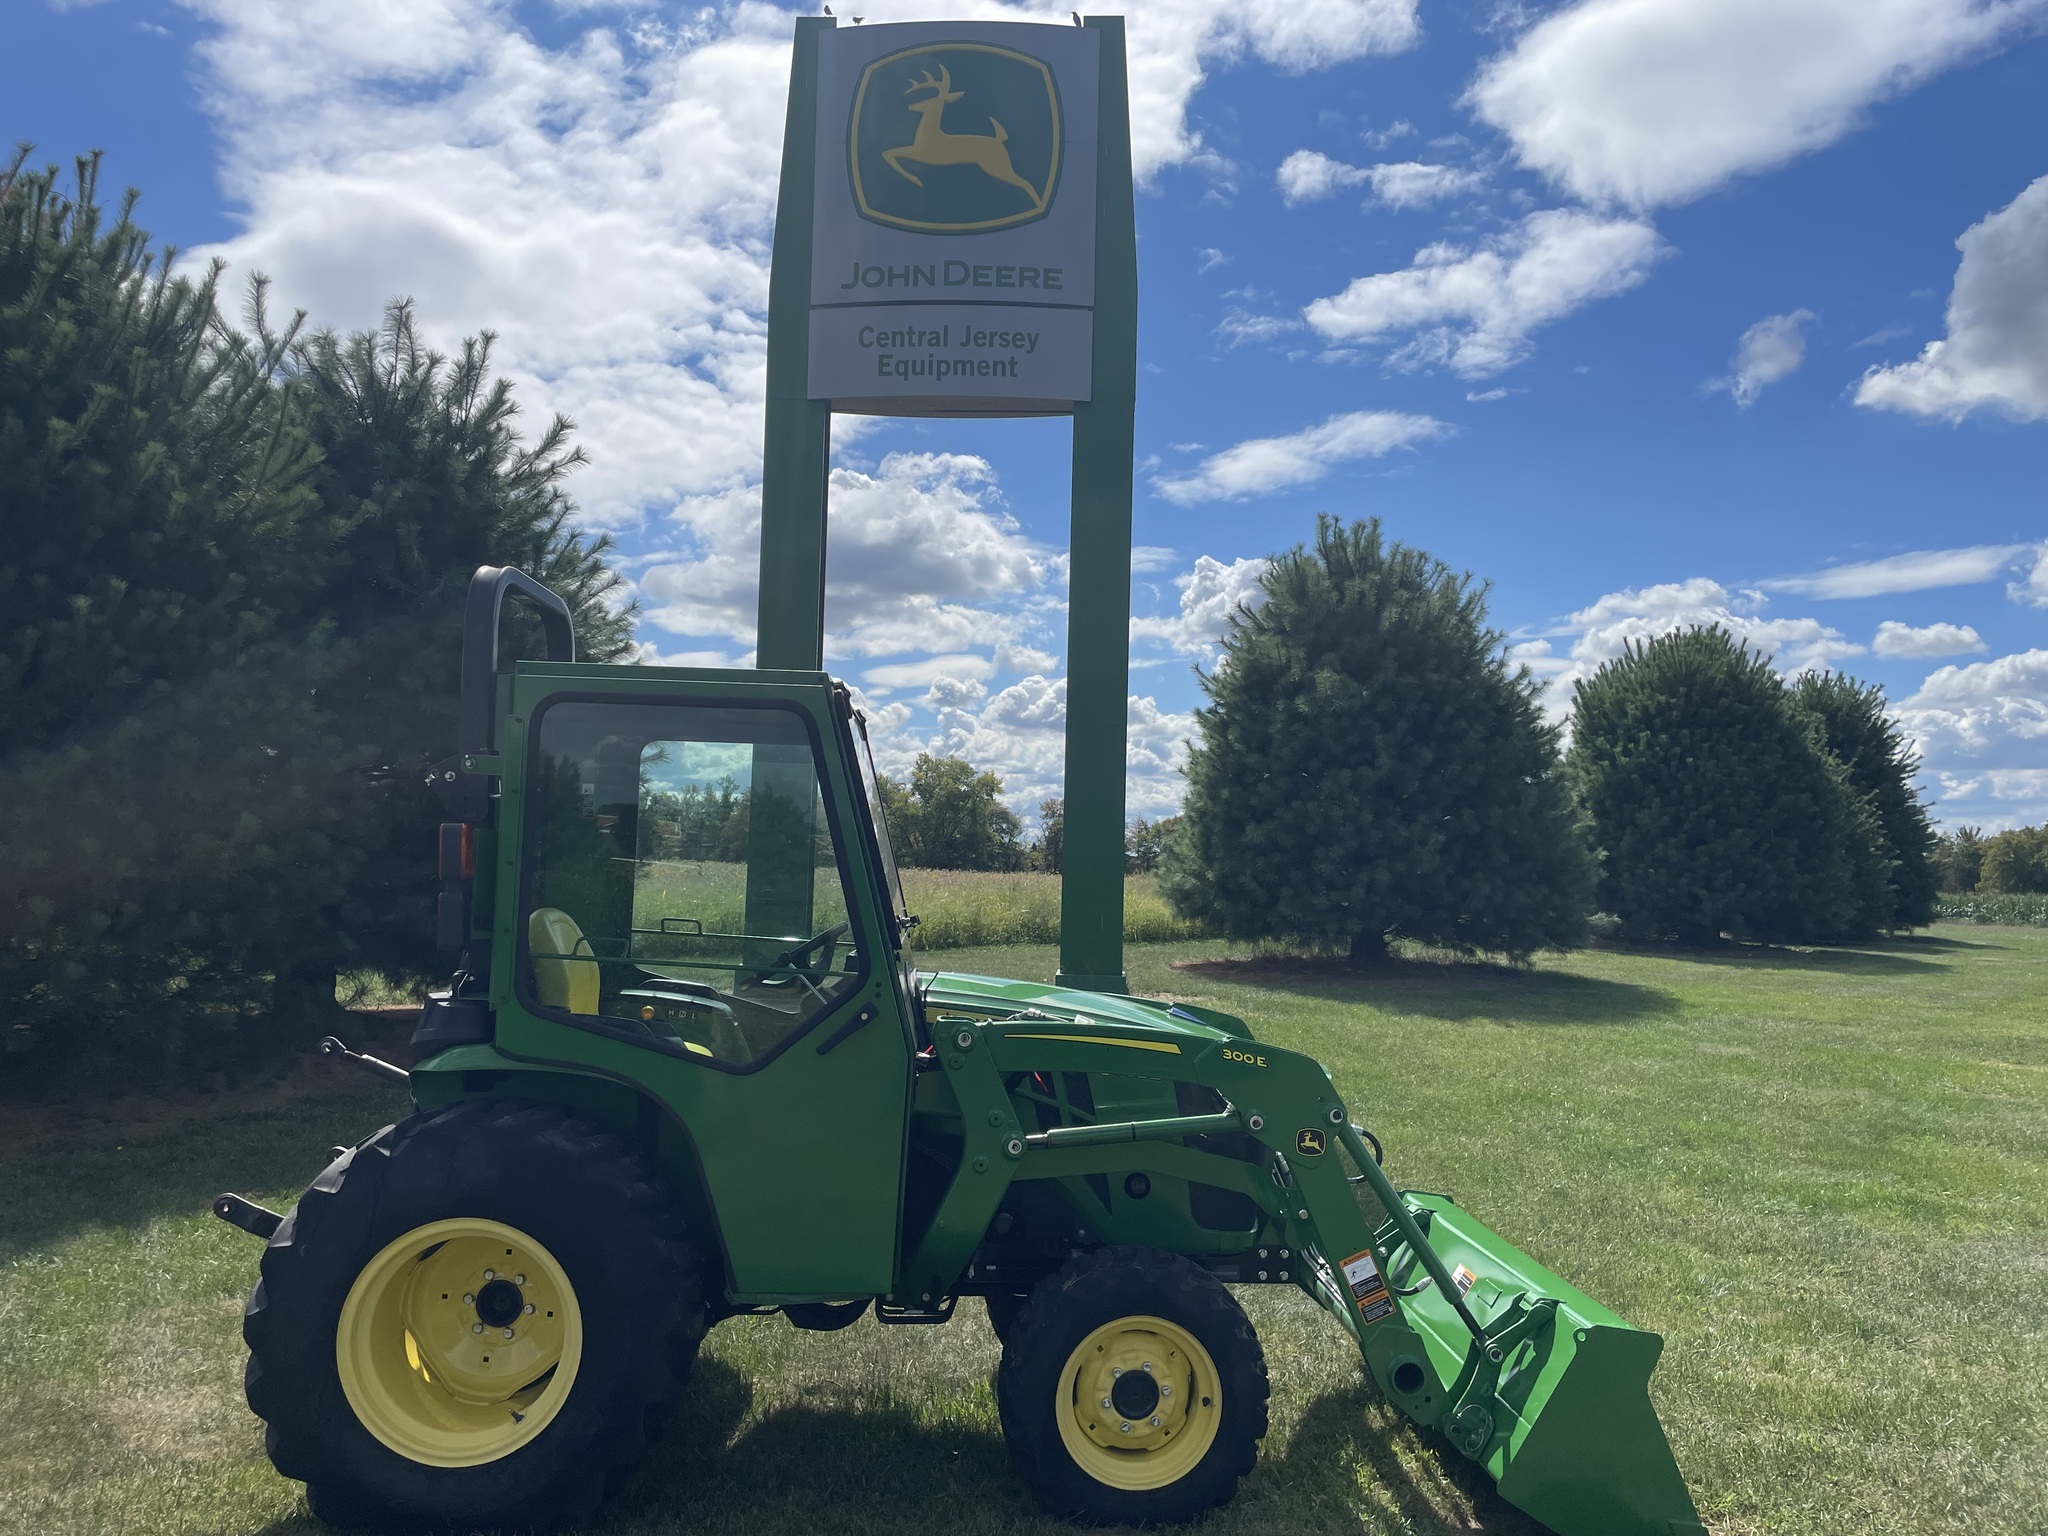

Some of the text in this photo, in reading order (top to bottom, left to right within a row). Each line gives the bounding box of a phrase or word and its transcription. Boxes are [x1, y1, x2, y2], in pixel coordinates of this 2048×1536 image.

[840, 260, 1064, 290] JOHN DEERE
[858, 325, 1040, 354] Central Jersey
[878, 353, 1018, 381] Equipment
[1365, 1292, 1386, 1304] WARNING
